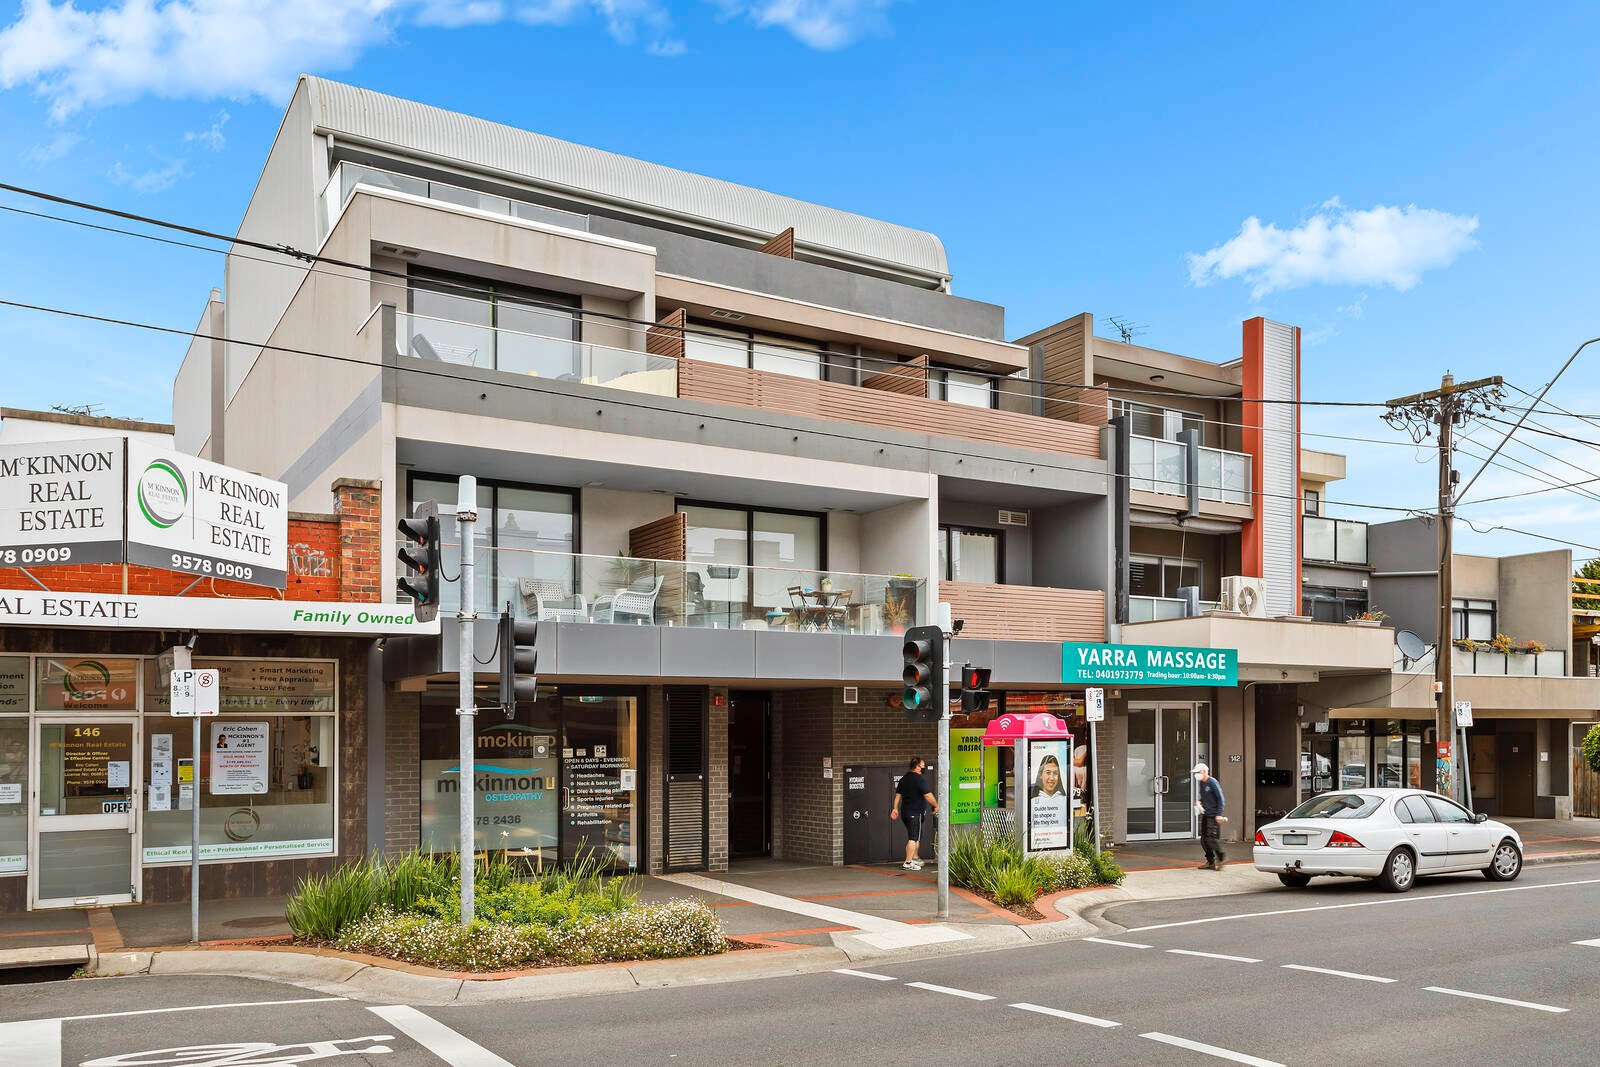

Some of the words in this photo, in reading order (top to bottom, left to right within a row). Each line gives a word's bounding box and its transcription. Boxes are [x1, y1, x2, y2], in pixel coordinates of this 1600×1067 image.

[29, 480, 92, 503] REAL
[19, 507, 105, 532] ESTATE
[220, 501, 265, 530] REAL
[211, 525, 272, 556] ESTATE
[21, 547, 72, 563] 0909
[171, 554, 213, 573] 9578
[216, 562, 253, 580] 0909
[40, 598, 139, 619] ESTATE
[293, 609, 351, 625] Family
[357, 612, 414, 625] Owned
[1077, 647, 1138, 666] YARRA
[1147, 650, 1226, 669] MASSAGE
[184, 672, 193, 683] P
[1077, 669, 1094, 679] TEL:
[1096, 670, 1144, 680] 0401973779
[1147, 672, 1167, 680] Trading
[74, 728, 101, 737] 146
[437, 774, 543, 793] mkinnon
[485, 792, 543, 801] OSTEOPATHY
[493, 815, 521, 825] 2436
[217, 845, 259, 853] Professional
